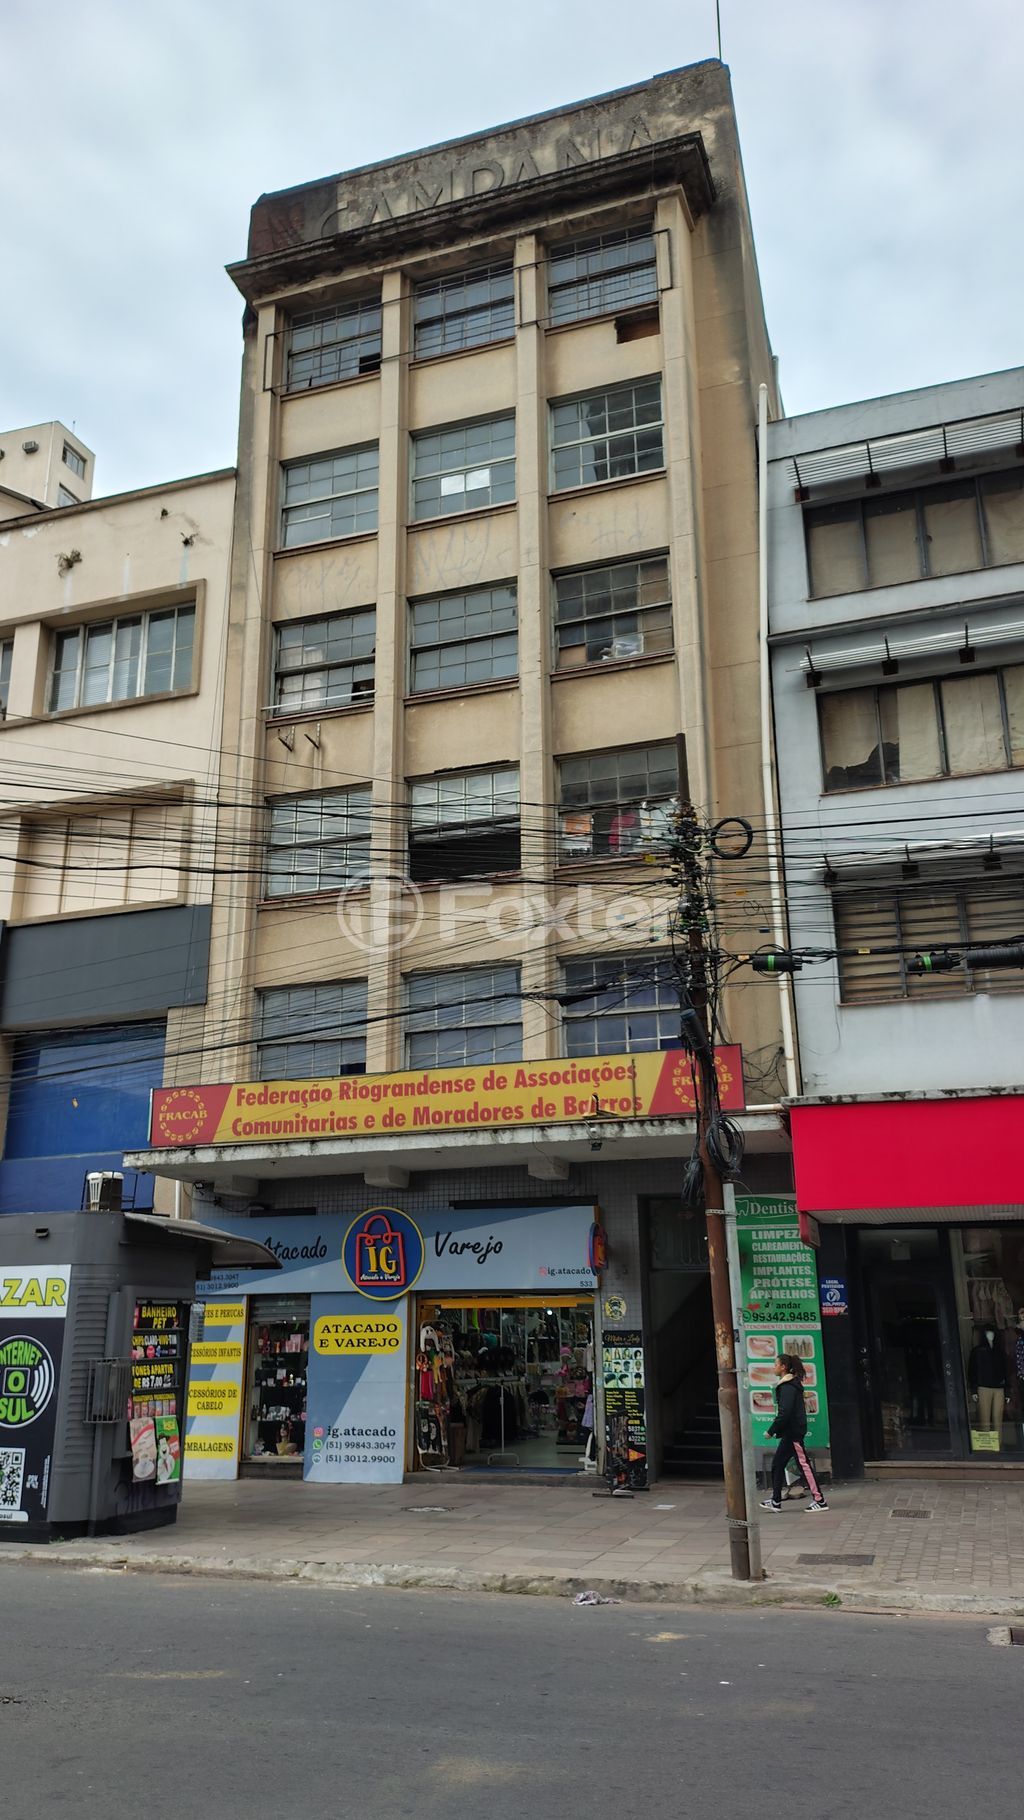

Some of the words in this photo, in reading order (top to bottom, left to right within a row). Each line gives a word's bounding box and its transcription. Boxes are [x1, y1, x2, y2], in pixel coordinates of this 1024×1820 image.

[236, 1083, 333, 1108] Federação
[338, 1072, 476, 1103] Riograndense
[483, 1070, 508, 1091] de
[513, 1062, 638, 1088] Associações
[159, 1108, 208, 1121] FRACAB
[232, 1111, 358, 1136] Comunitarias
[364, 1114, 376, 1129] e
[381, 1107, 406, 1128] de
[413, 1101, 525, 1126] Moradores
[531, 1097, 557, 1118] de
[435, 1231, 503, 1264] Varejo
[364, 1245, 397, 1274] IG
[548, 1266, 592, 1276] ig.atacado
[0, 1277, 67, 1307] ZAR
[750, 1289, 816, 1299] APARELHOS
[142, 1306, 177, 1318] BANHEIRO
[214, 1309, 219, 1317] E
[220, 1307, 244, 1318] PERUCAS
[752, 1311, 817, 1323] 99342.9485
[152, 1318, 167, 1328] PET
[321, 1323, 398, 1334] ATACADO
[319, 1338, 329, 1348] E
[333, 1337, 400, 1348] VAREJO
[218, 1347, 242, 1357] INFANTIS
[227, 1389, 238, 1398] DE
[0, 1397, 34, 1423] SUL
[196, 1401, 223, 1411] CABELO
[327, 1426, 396, 1439] ig.atacado
[325, 1441, 342, 1450] (51)
[345, 1441, 396, 1450] 99843.3047
[325, 1455, 342, 1463] (51)
[344, 1455, 396, 1463] 3012.9900
